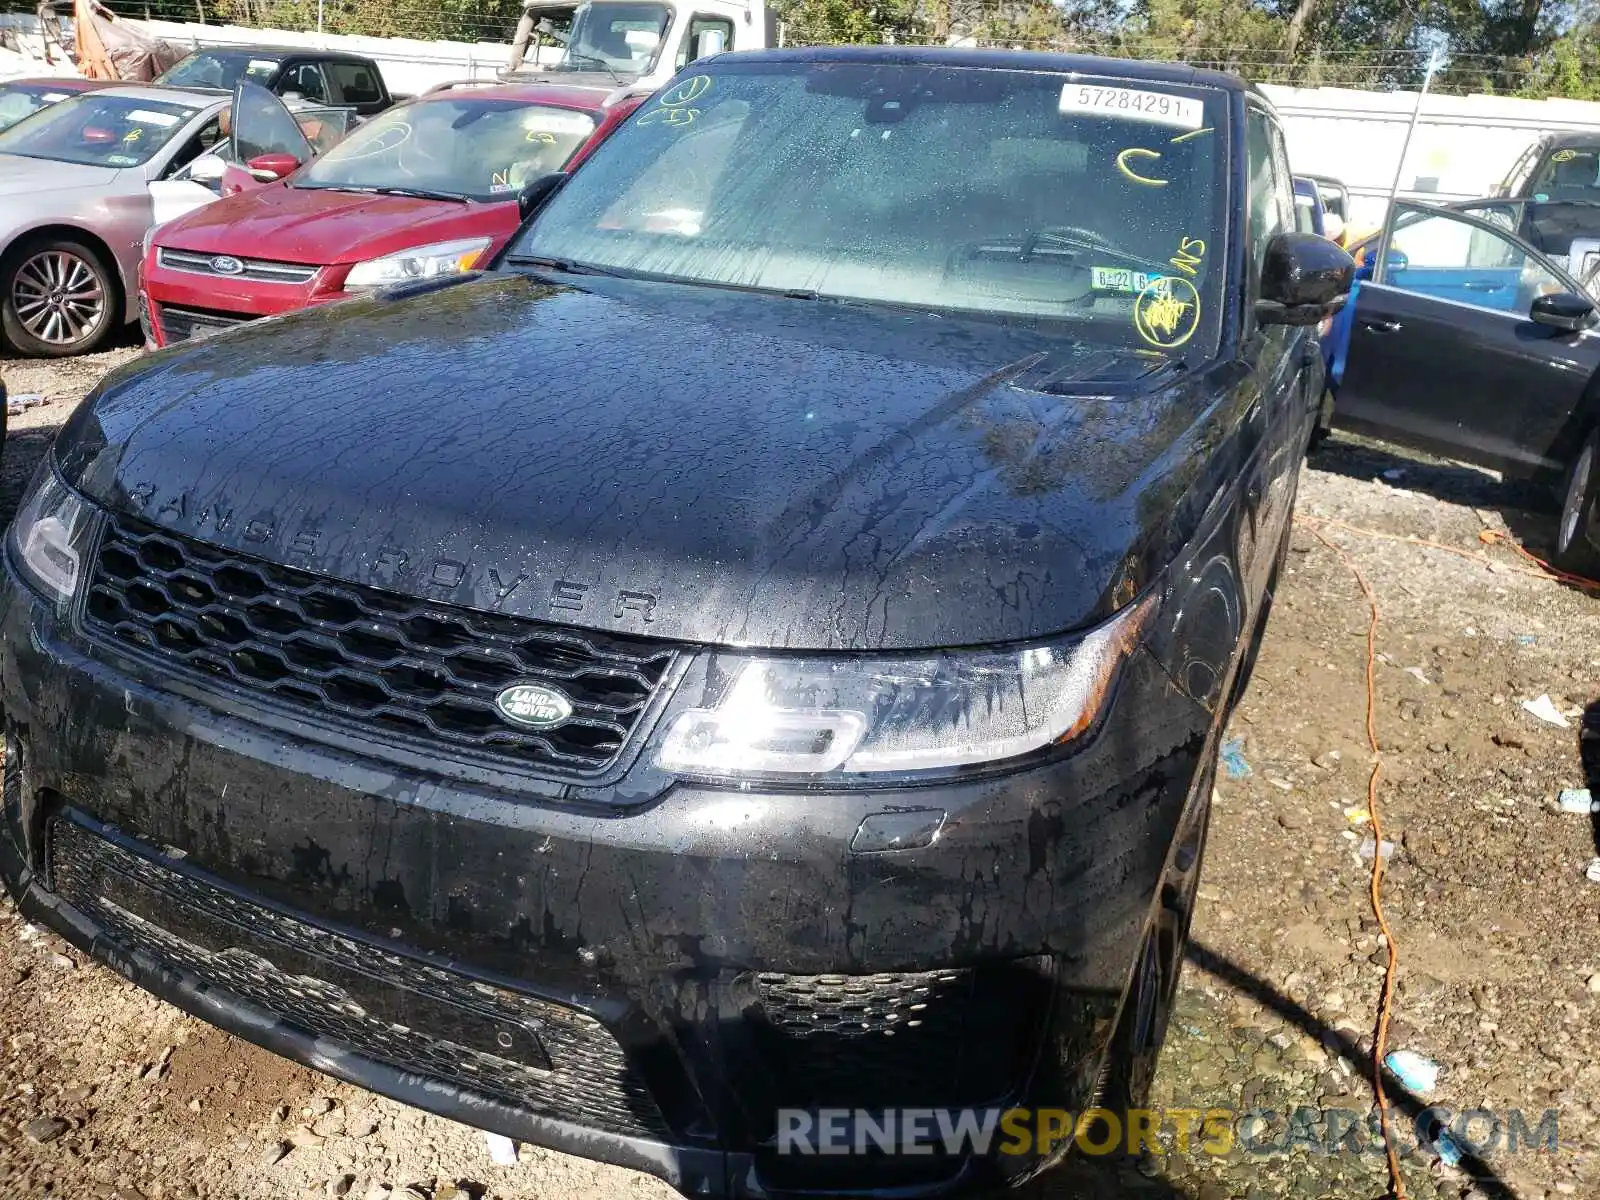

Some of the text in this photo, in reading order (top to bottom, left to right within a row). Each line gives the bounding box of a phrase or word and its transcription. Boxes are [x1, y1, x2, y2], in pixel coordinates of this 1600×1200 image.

[1077, 87, 1183, 117] 57284291
[370, 550, 658, 623] ROVER
[510, 689, 550, 706] LAND
[509, 701, 558, 720] ROVER
